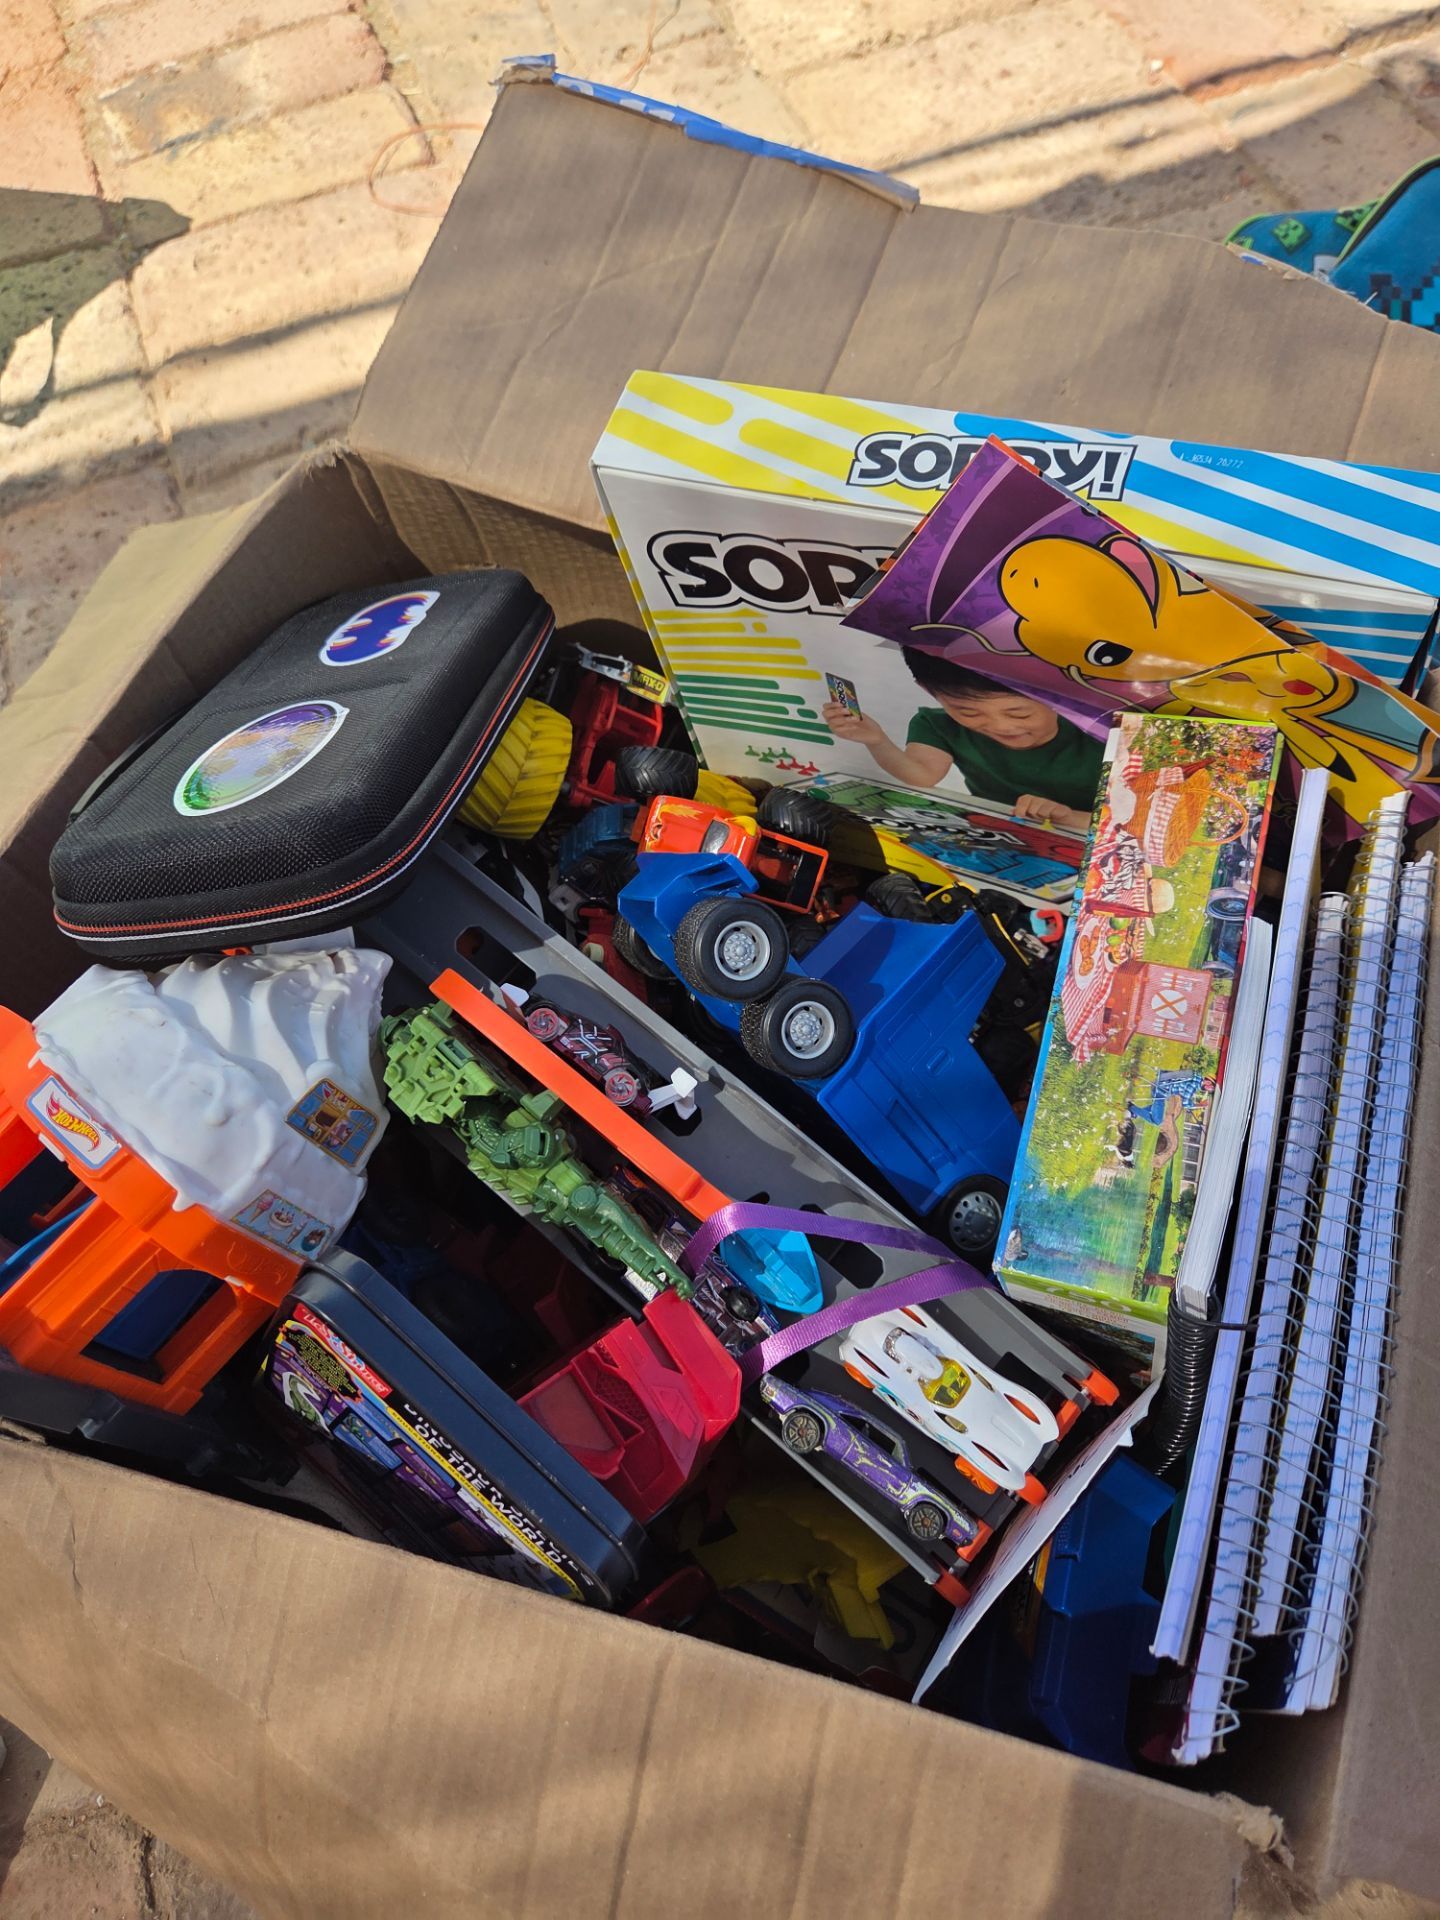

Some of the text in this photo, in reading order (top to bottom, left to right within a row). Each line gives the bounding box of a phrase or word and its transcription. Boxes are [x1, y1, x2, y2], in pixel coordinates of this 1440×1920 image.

[654, 533, 893, 611] SOR
[414, 1424, 562, 1564] OF THE WORLD
